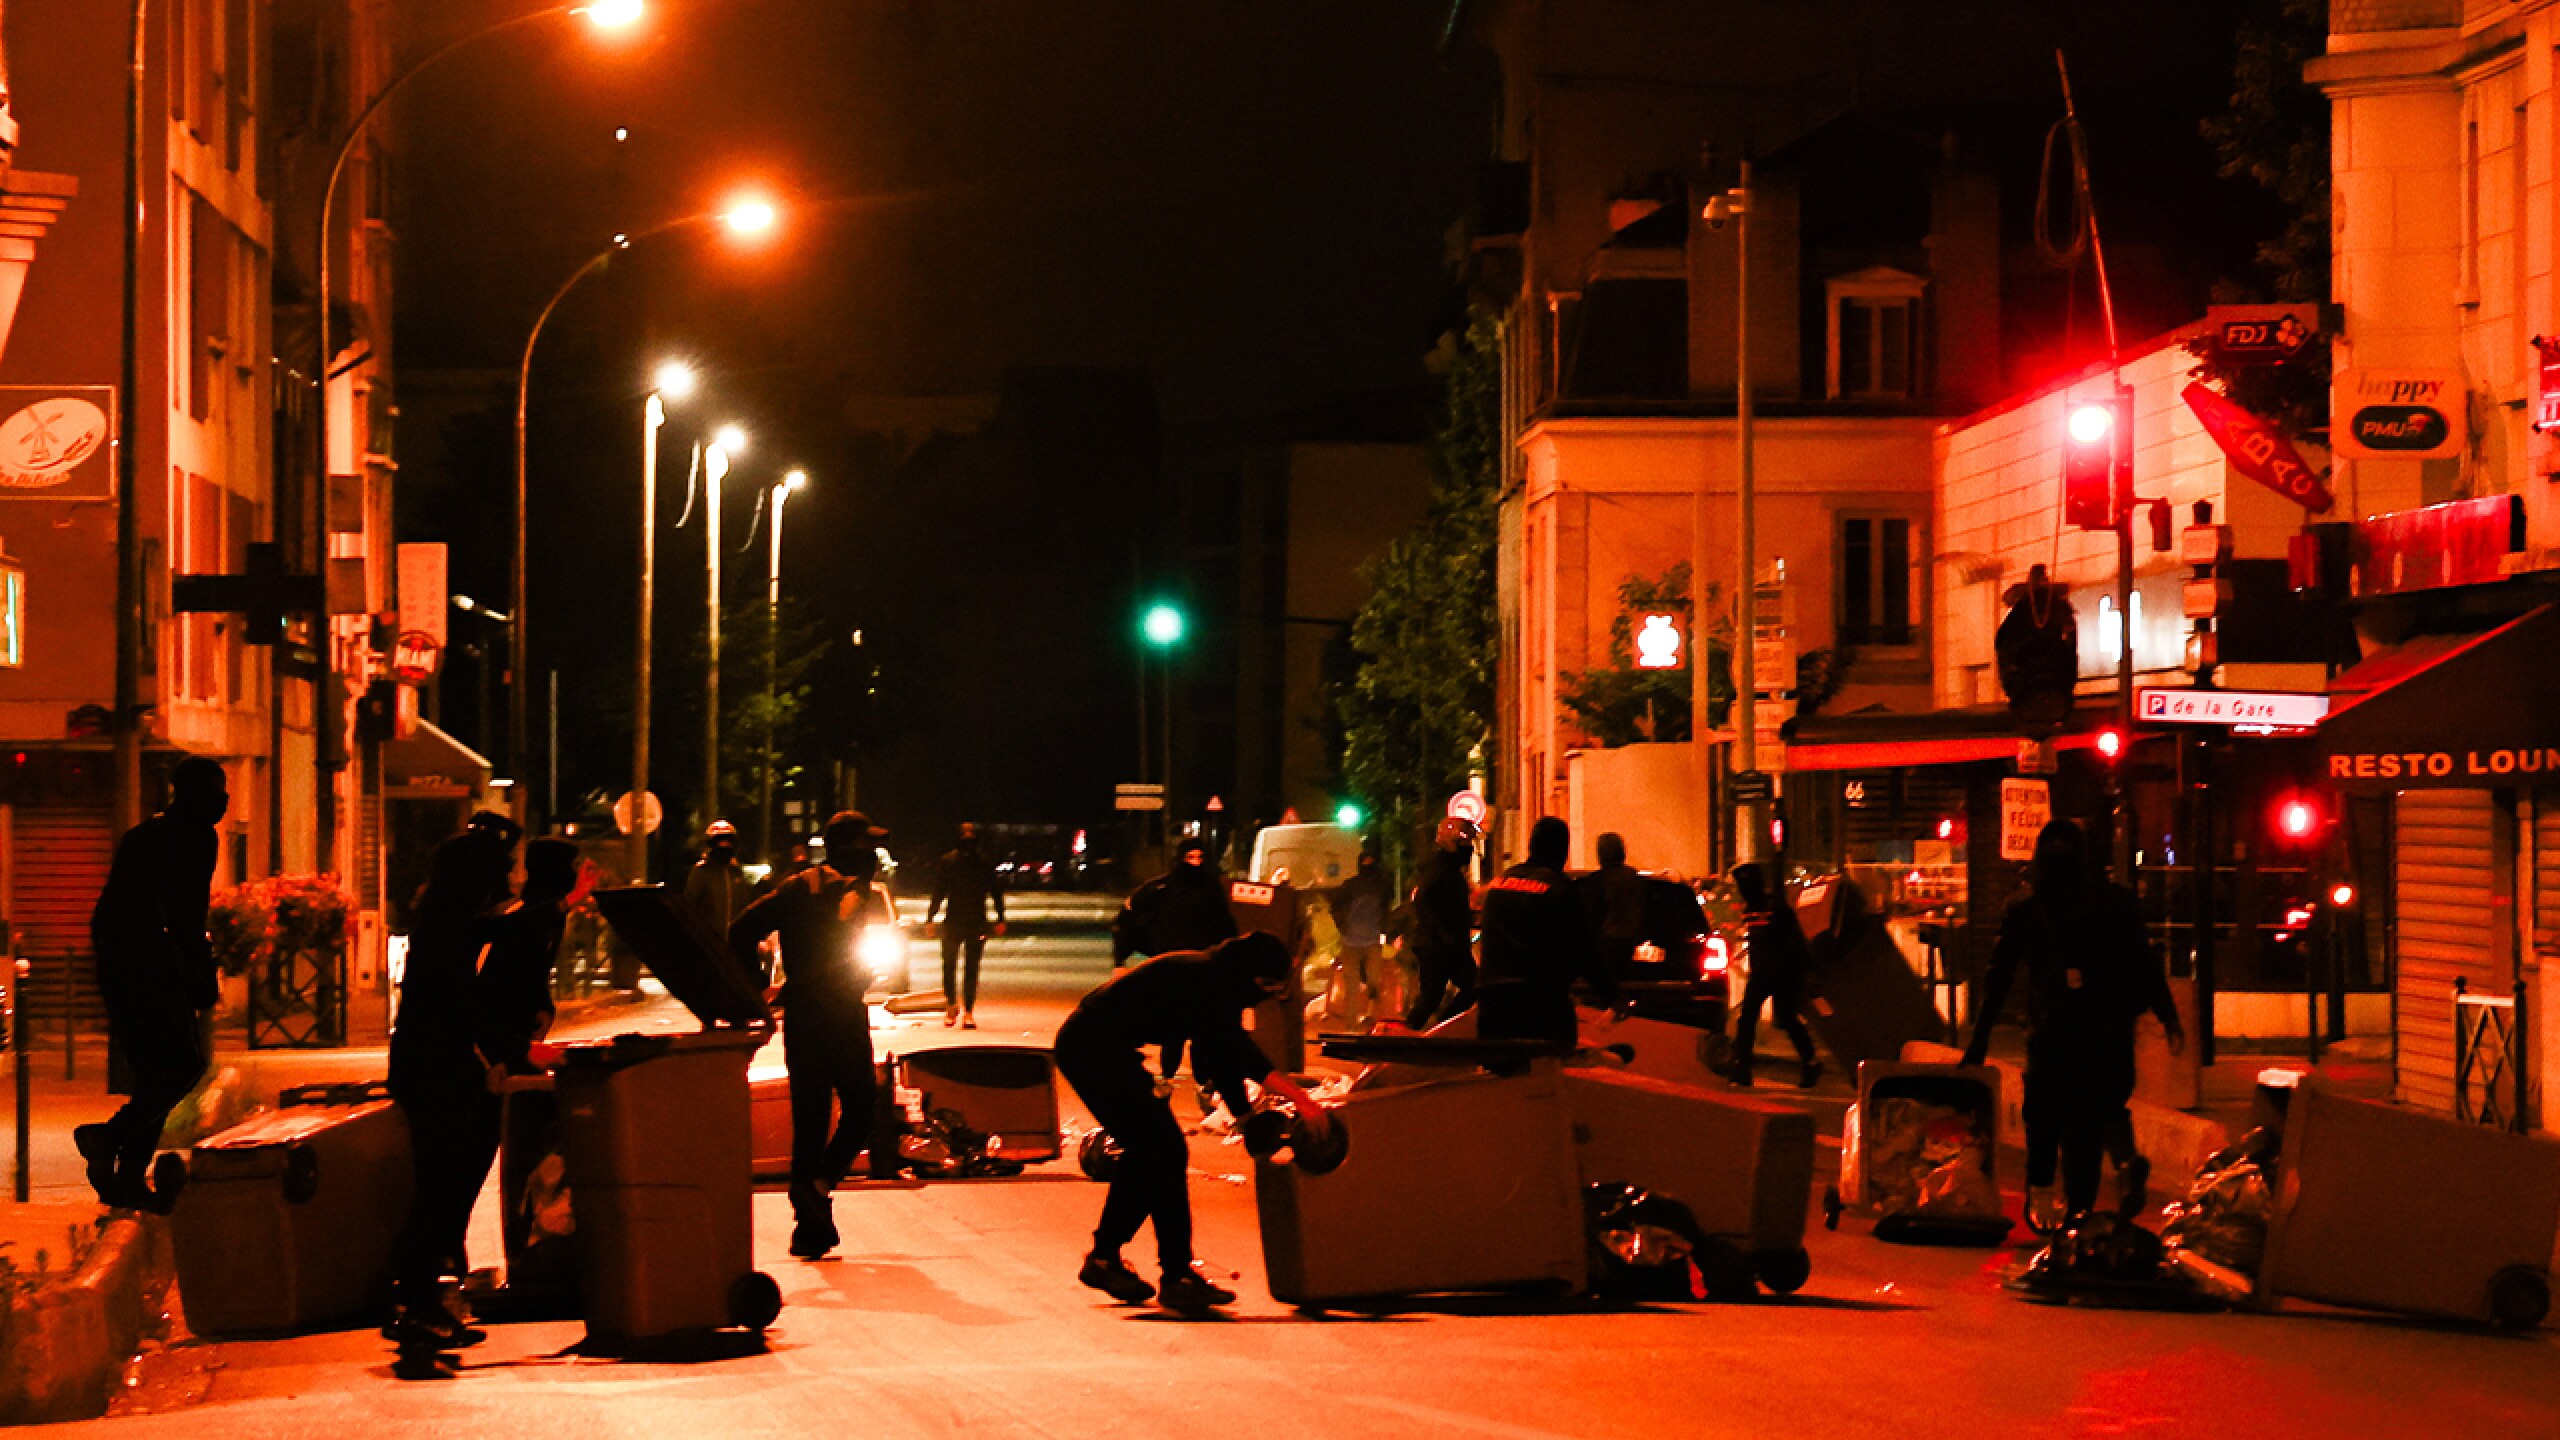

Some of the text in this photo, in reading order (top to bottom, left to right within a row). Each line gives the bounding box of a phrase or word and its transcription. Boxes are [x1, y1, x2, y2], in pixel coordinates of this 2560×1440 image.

[2227, 325, 2268, 344] FDJ
[2357, 371, 2445, 403] happy
[2361, 421, 2406, 437] PMU
[2173, 698, 2195, 715] de
[2204, 699, 2222, 716] la
[2232, 699, 2275, 717] Gare
[2329, 752, 2453, 778] RESTO
[1845, 781, 1865, 801] 66
